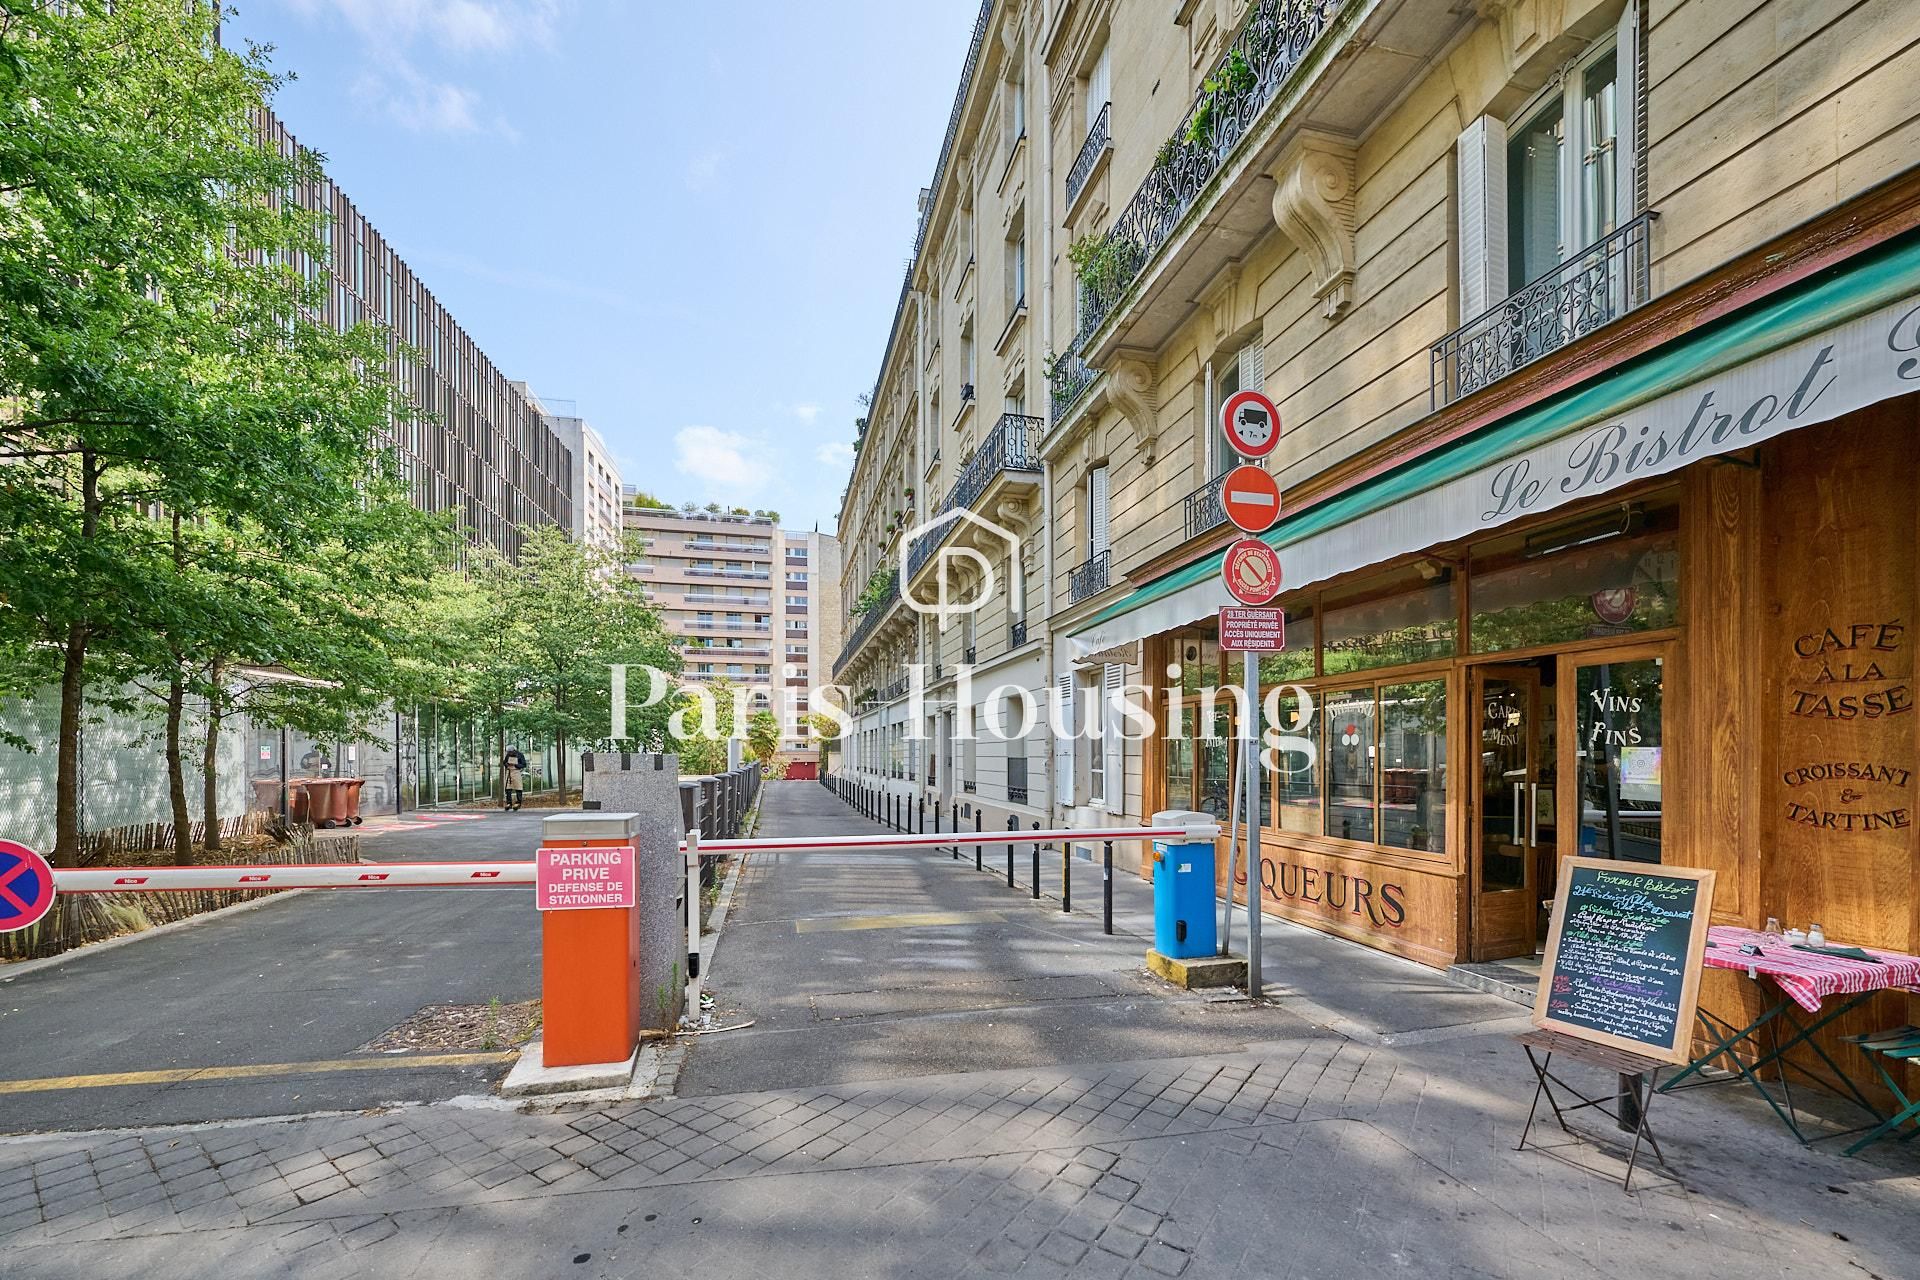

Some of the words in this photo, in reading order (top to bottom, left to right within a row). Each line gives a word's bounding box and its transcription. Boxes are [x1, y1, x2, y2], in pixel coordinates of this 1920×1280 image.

[1480, 459, 1552, 522] Le
[1560, 344, 1838, 494] Bistrot
[1235, 610, 1246, 619] TER
[1226, 620, 1258, 629] PROPRIÉTÉ
[1258, 620, 1279, 629] PRIVÉE
[1224, 629, 1244, 638] ACCÈS
[1245, 631, 1281, 639] UNIQUEMENT
[1793, 619, 1904, 659] CAFÉ
[1244, 639, 1275, 648] RÉSIDENTS
[1844, 662, 1887, 682] LA
[1590, 687, 1642, 713] VINS
[1789, 685, 1913, 720] TASSE
[1593, 721, 1642, 747] FINS
[1783, 762, 1912, 788] CROISSANT
[1840, 788, 1864, 804] &
[1786, 802, 1911, 832] TARTINE
[550, 852, 622, 866] PARKING
[562, 867, 609, 880] PRIVE
[548, 882, 604, 893] DEFENSE
[607, 882, 623, 891] DE
[549, 894, 623, 905] STATIONNER
